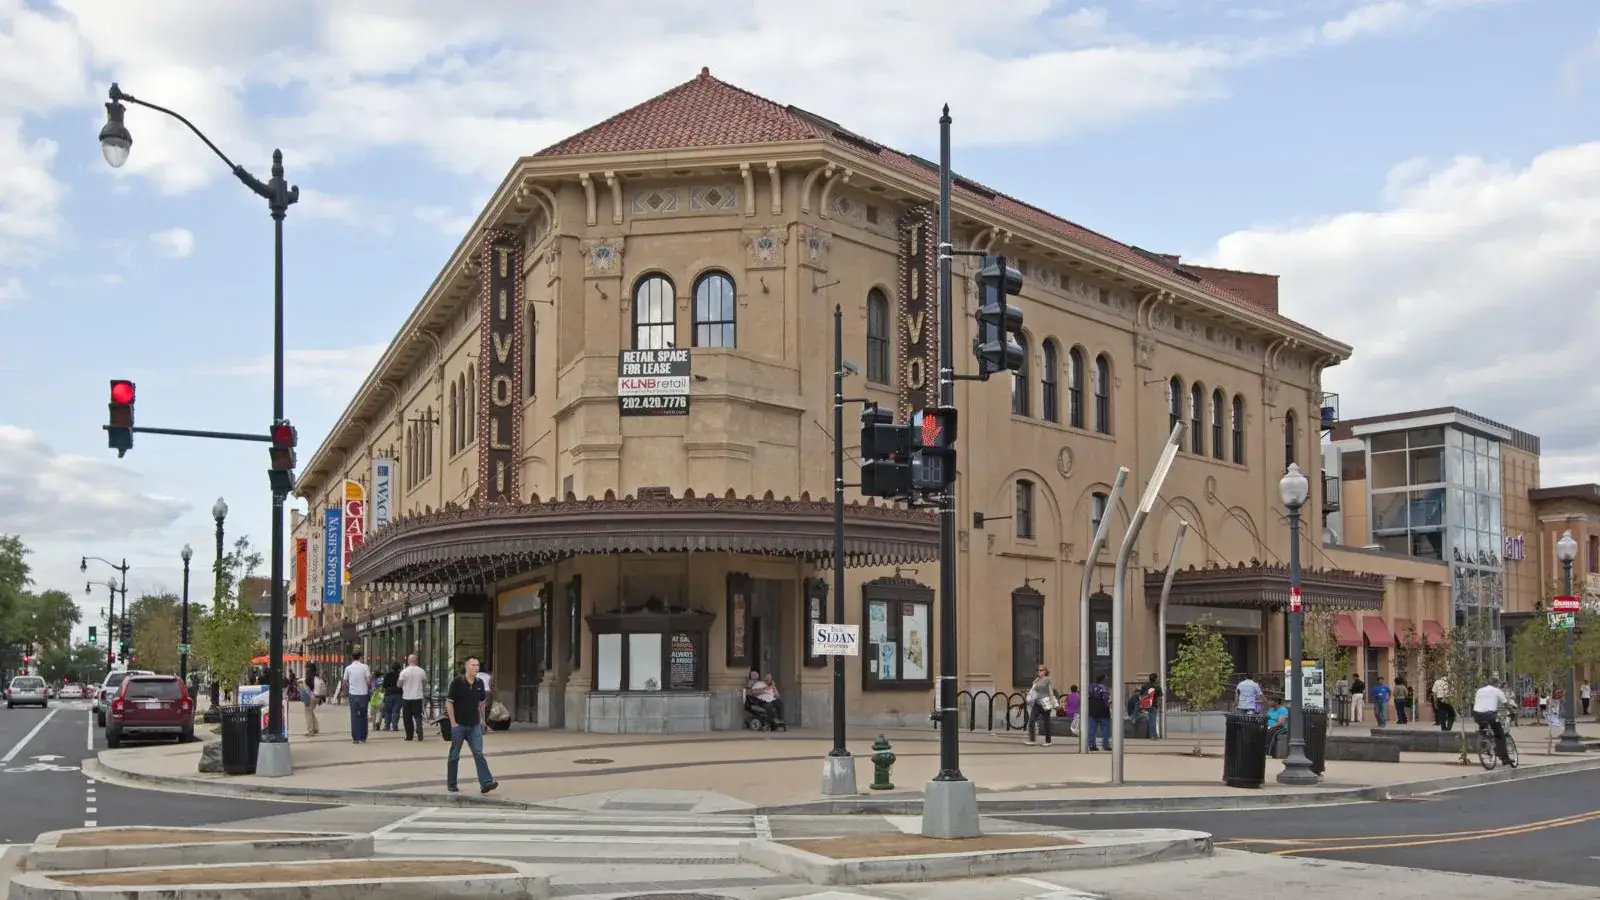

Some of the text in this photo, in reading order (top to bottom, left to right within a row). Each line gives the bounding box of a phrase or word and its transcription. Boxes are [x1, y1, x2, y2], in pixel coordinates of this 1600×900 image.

[903, 222, 926, 412] TIVO
[490, 246, 514, 493] TIVOLI
[623, 350, 688, 363] RETAIL SPACE
[623, 363, 672, 375] FOR LEASE
[622, 397, 687, 409] 202.420.7776
[327, 517, 339, 596] NASH'S SPORTS
